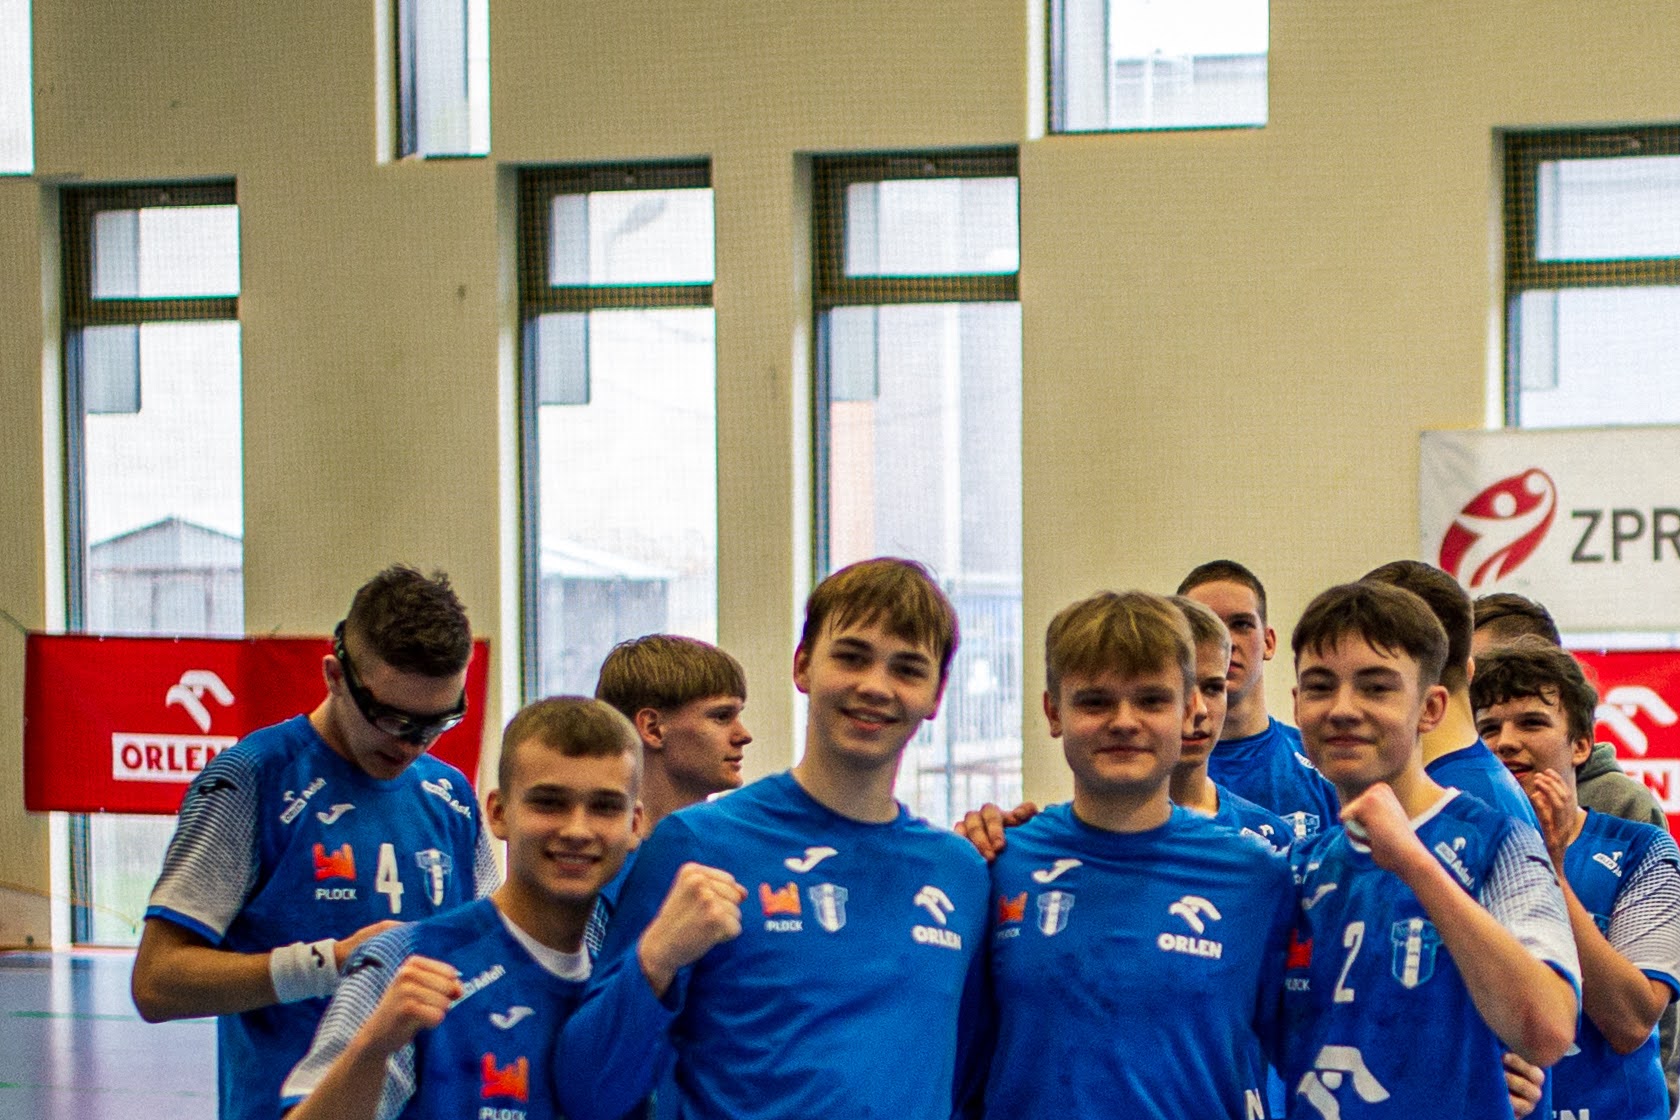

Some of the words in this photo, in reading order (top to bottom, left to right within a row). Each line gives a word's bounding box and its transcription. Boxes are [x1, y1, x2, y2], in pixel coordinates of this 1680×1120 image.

[375, 842, 404, 914] 4
[911, 925, 962, 951] ORLEN
[1156, 932, 1223, 960] ORLEN
[1334, 922, 1365, 1003] 2
